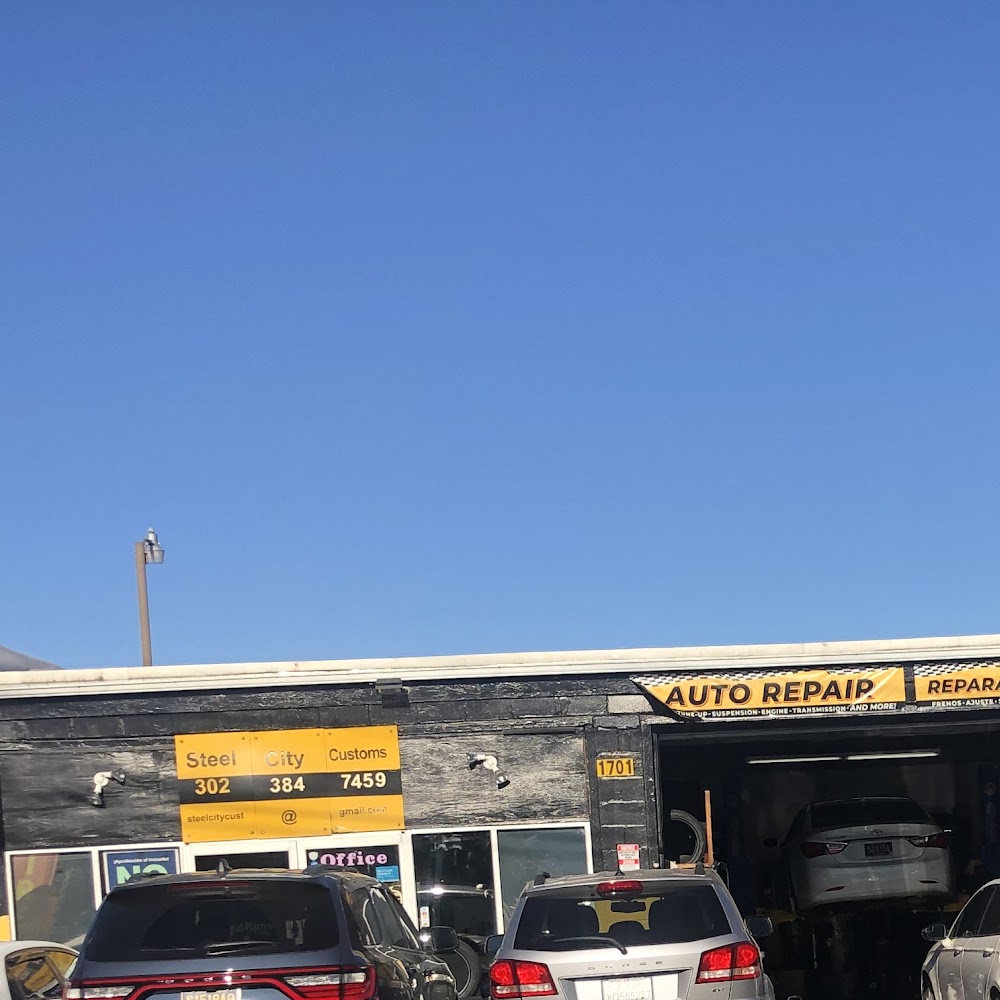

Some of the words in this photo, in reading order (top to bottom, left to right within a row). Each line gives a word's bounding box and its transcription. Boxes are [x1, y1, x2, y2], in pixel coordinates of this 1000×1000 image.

[665, 683, 751, 707] AUTO
[762, 678, 875, 703] REPAIR
[711, 709, 758, 717] SUSPENSION
[793, 705, 846, 713] TRANSMISSION
[850, 704, 868, 712] AND
[870, 702, 897, 710] MORE!
[186, 750, 237, 769] Steel
[265, 751, 305, 770] City
[328, 747, 388, 762] Customs
[599, 759, 633, 776] 1701
[194, 778, 231, 795] 302
[269, 777, 306, 794] 384
[340, 772, 387, 790] 7459
[187, 811, 245, 823] steelcitycust
[281, 809, 298, 825] @
[320, 850, 388, 866] Office
